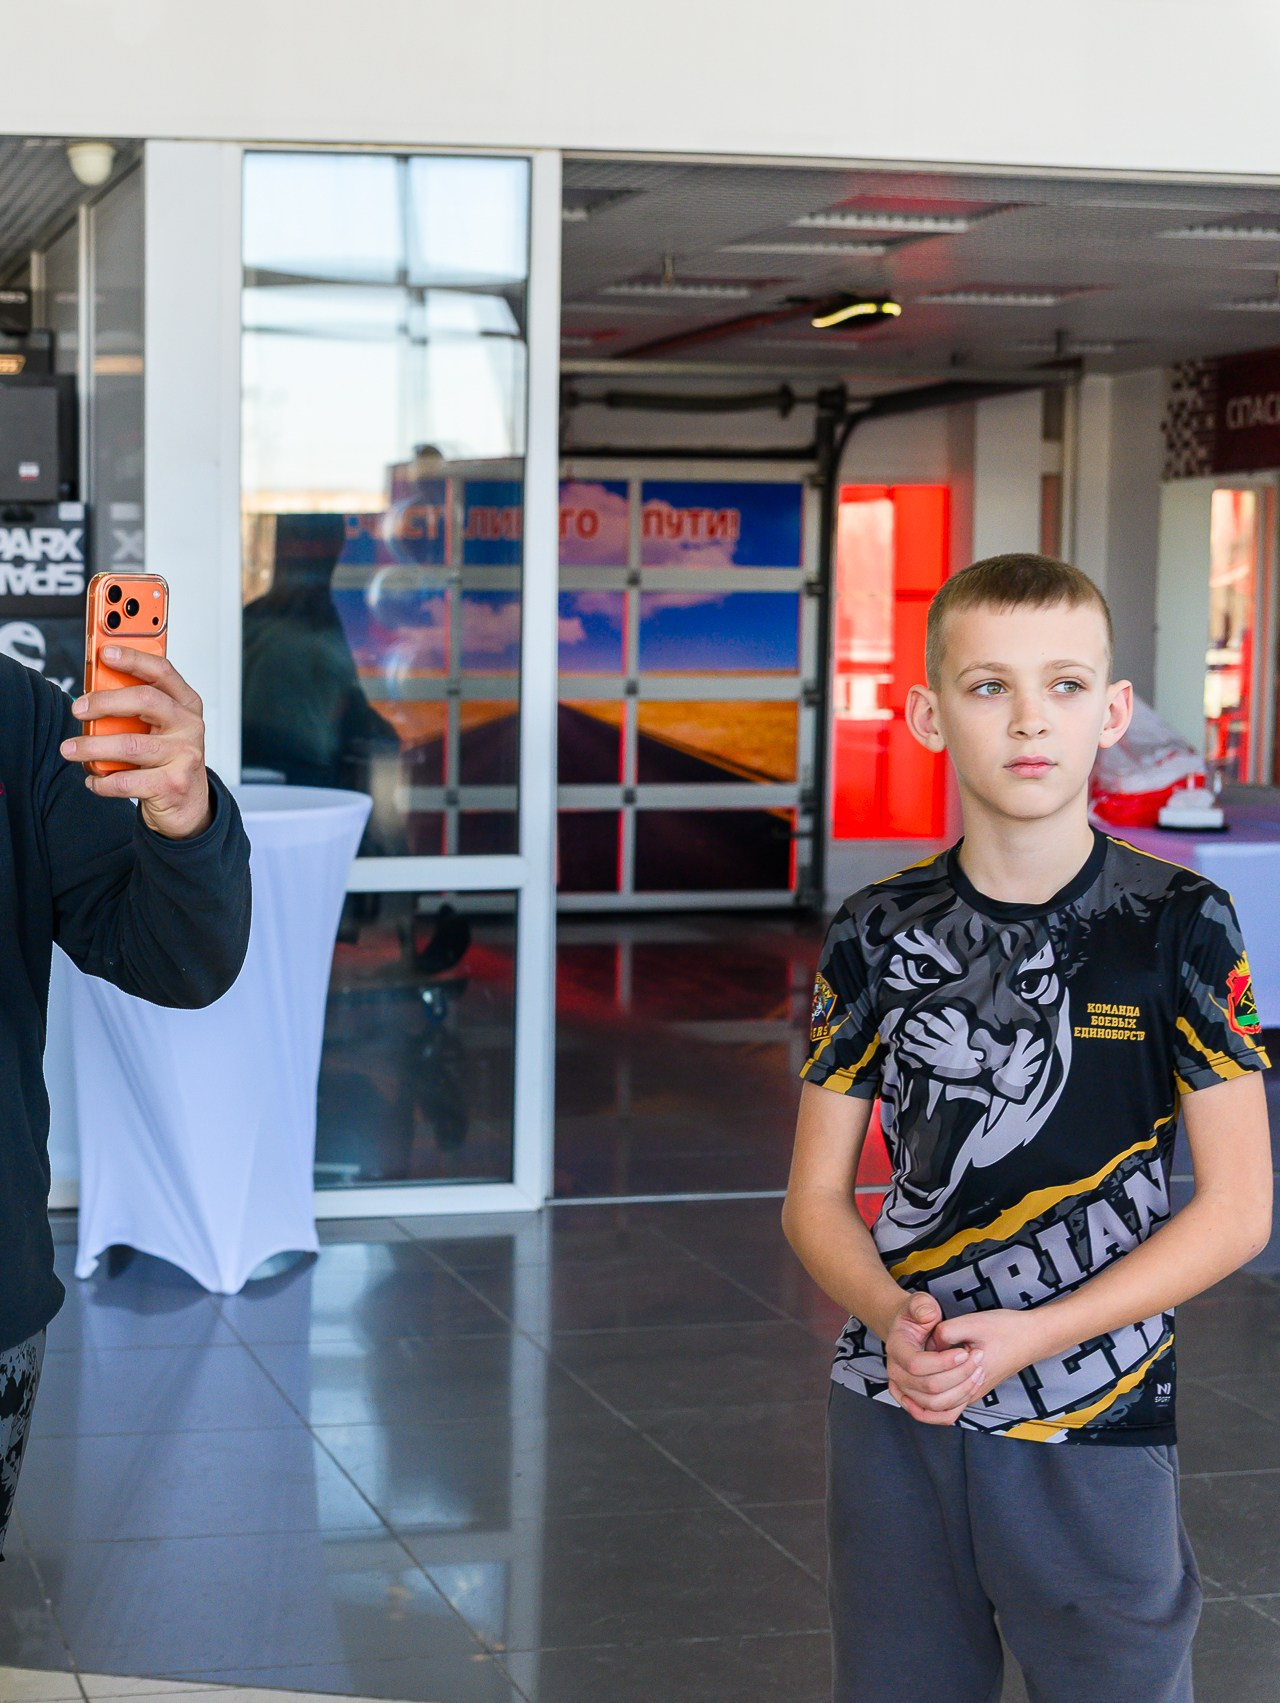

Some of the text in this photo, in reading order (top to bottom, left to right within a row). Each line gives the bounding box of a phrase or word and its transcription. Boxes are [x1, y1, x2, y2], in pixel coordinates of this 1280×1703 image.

[1226, 393, 1280, 430] СПАС
[641, 506, 741, 540] ПУТИ!
[1086, 1003, 1141, 1018] КОМАНДА
[1090, 1015, 1137, 1029] БОЕВЫХ
[1073, 1026, 1146, 1041] ЕДИНОБОРСТВ
